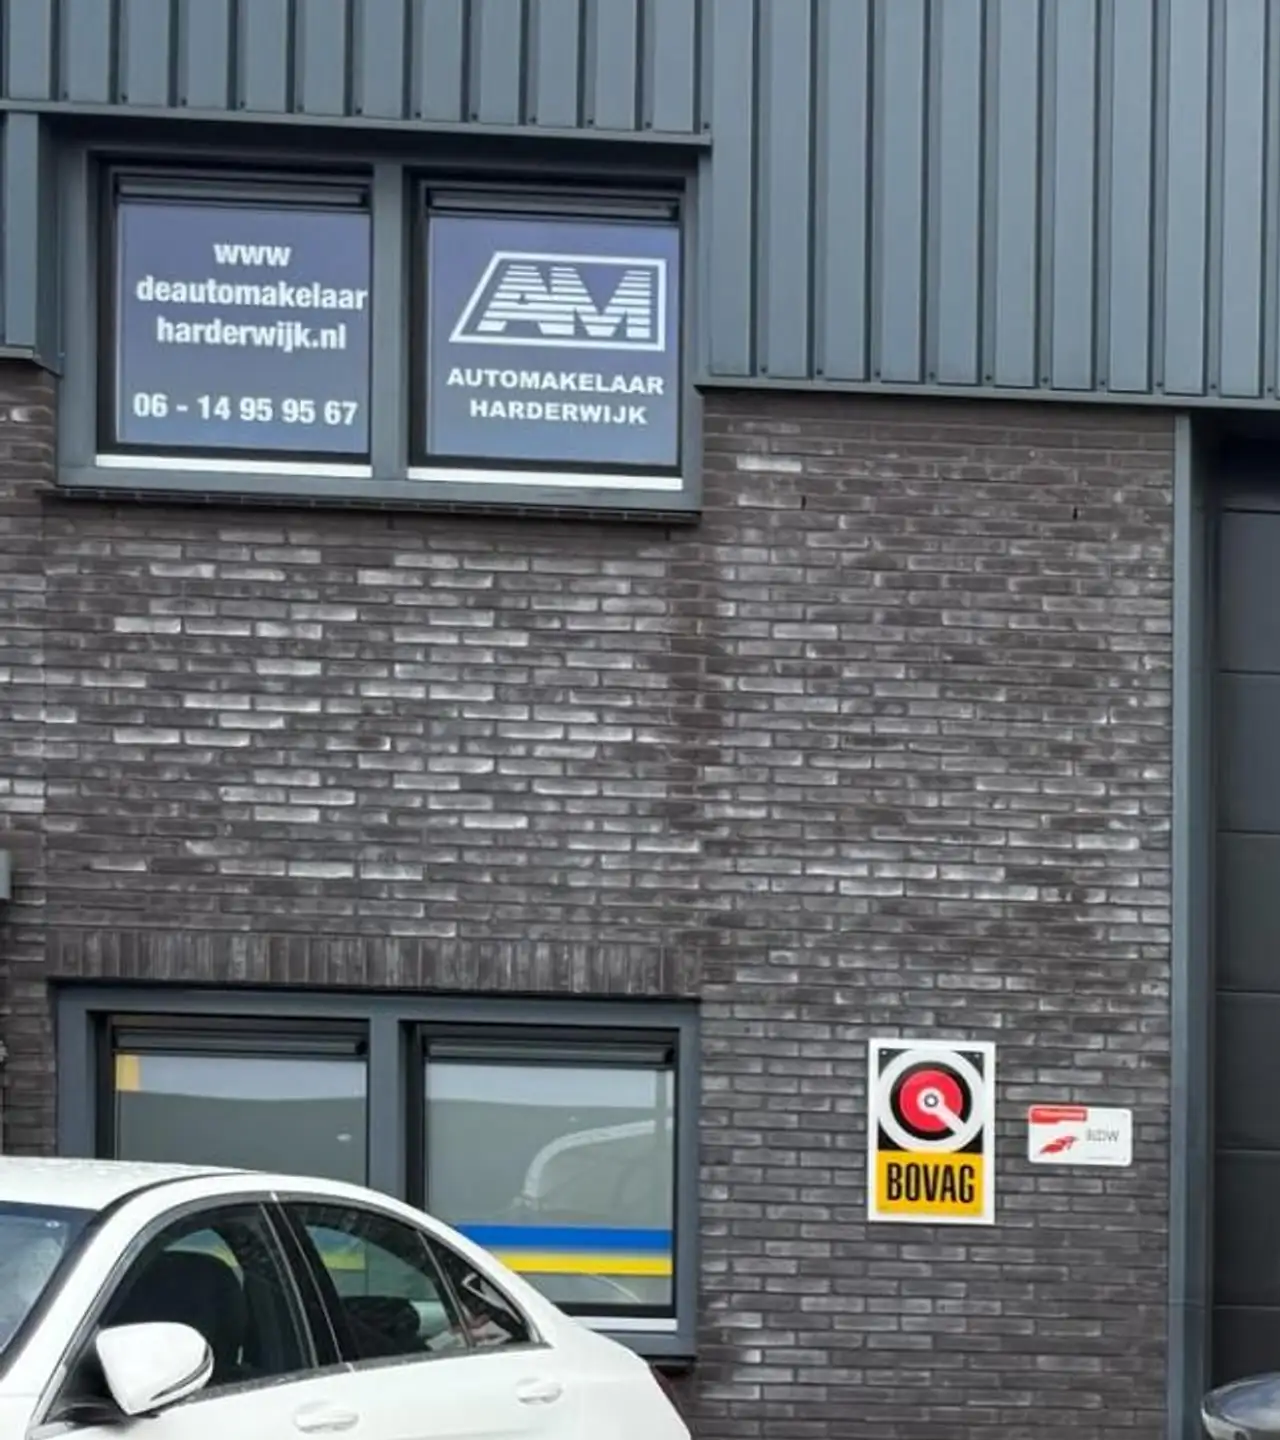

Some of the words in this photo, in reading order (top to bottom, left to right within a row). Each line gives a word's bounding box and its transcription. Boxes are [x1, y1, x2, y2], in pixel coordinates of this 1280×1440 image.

[213, 243, 291, 267] www
[136, 275, 369, 310] deautomakelaar
[156, 315, 347, 353] harderwijk.nl
[446, 367, 665, 395] AUTOMAKELAAR
[133, 392, 168, 418] 06
[197, 394, 231, 421] 14
[239, 396, 273, 422] 95
[281, 398, 316, 424] 95
[323, 400, 358, 426] 67
[469, 398, 648, 426] HARDERWIJK
[886, 1162, 975, 1204] BOVAG
